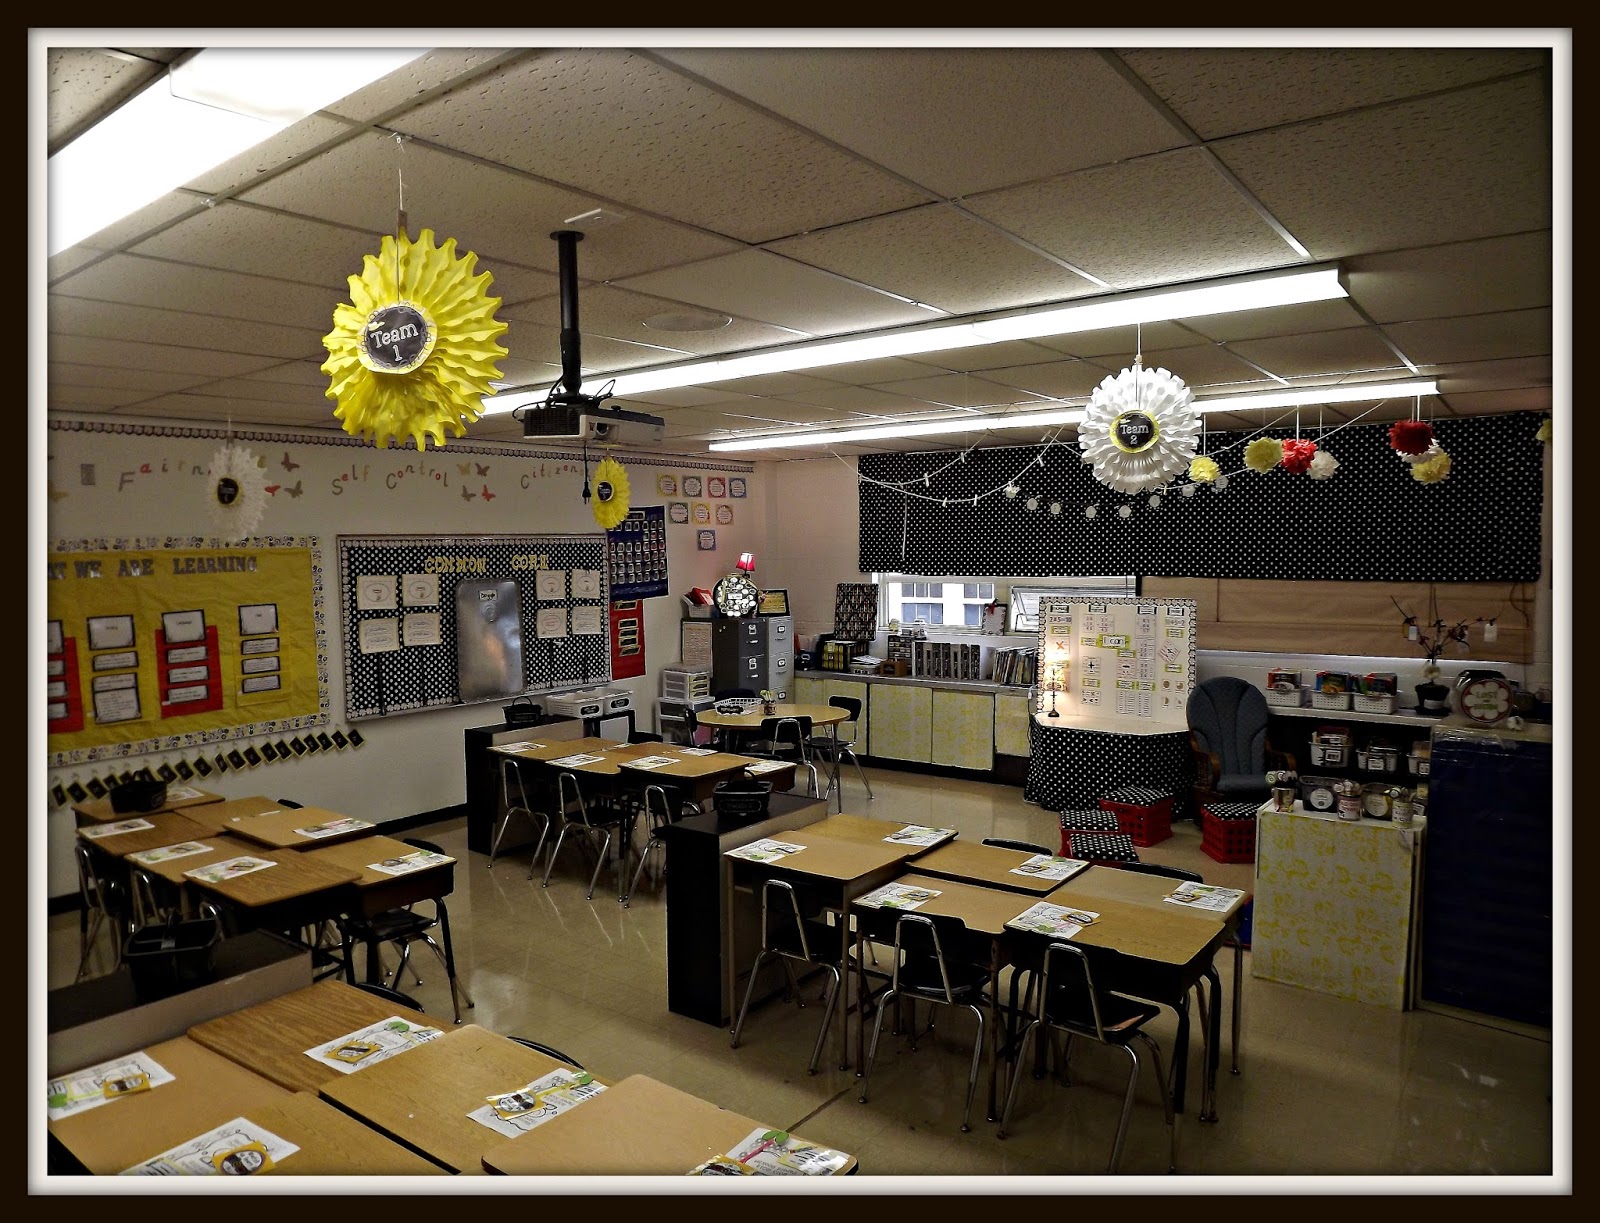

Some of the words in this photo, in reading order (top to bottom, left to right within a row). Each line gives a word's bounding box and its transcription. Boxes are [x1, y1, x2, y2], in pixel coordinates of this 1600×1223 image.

[369, 323, 419, 349] Team
[392, 344, 403, 361] 1
[1120, 424, 1149, 435] Team
[1130, 434, 1138, 445] 2
[118, 459, 211, 492] Fairn
[331, 464, 369, 495] Self
[386, 462, 449, 489] Control
[48, 561, 67, 580] AT
[74, 560, 102, 579] WE
[118, 558, 155, 577] ARE
[173, 556, 258, 575] LEARNING
[424, 555, 487, 574] COMMON
[511, 553, 549, 571] CORE
